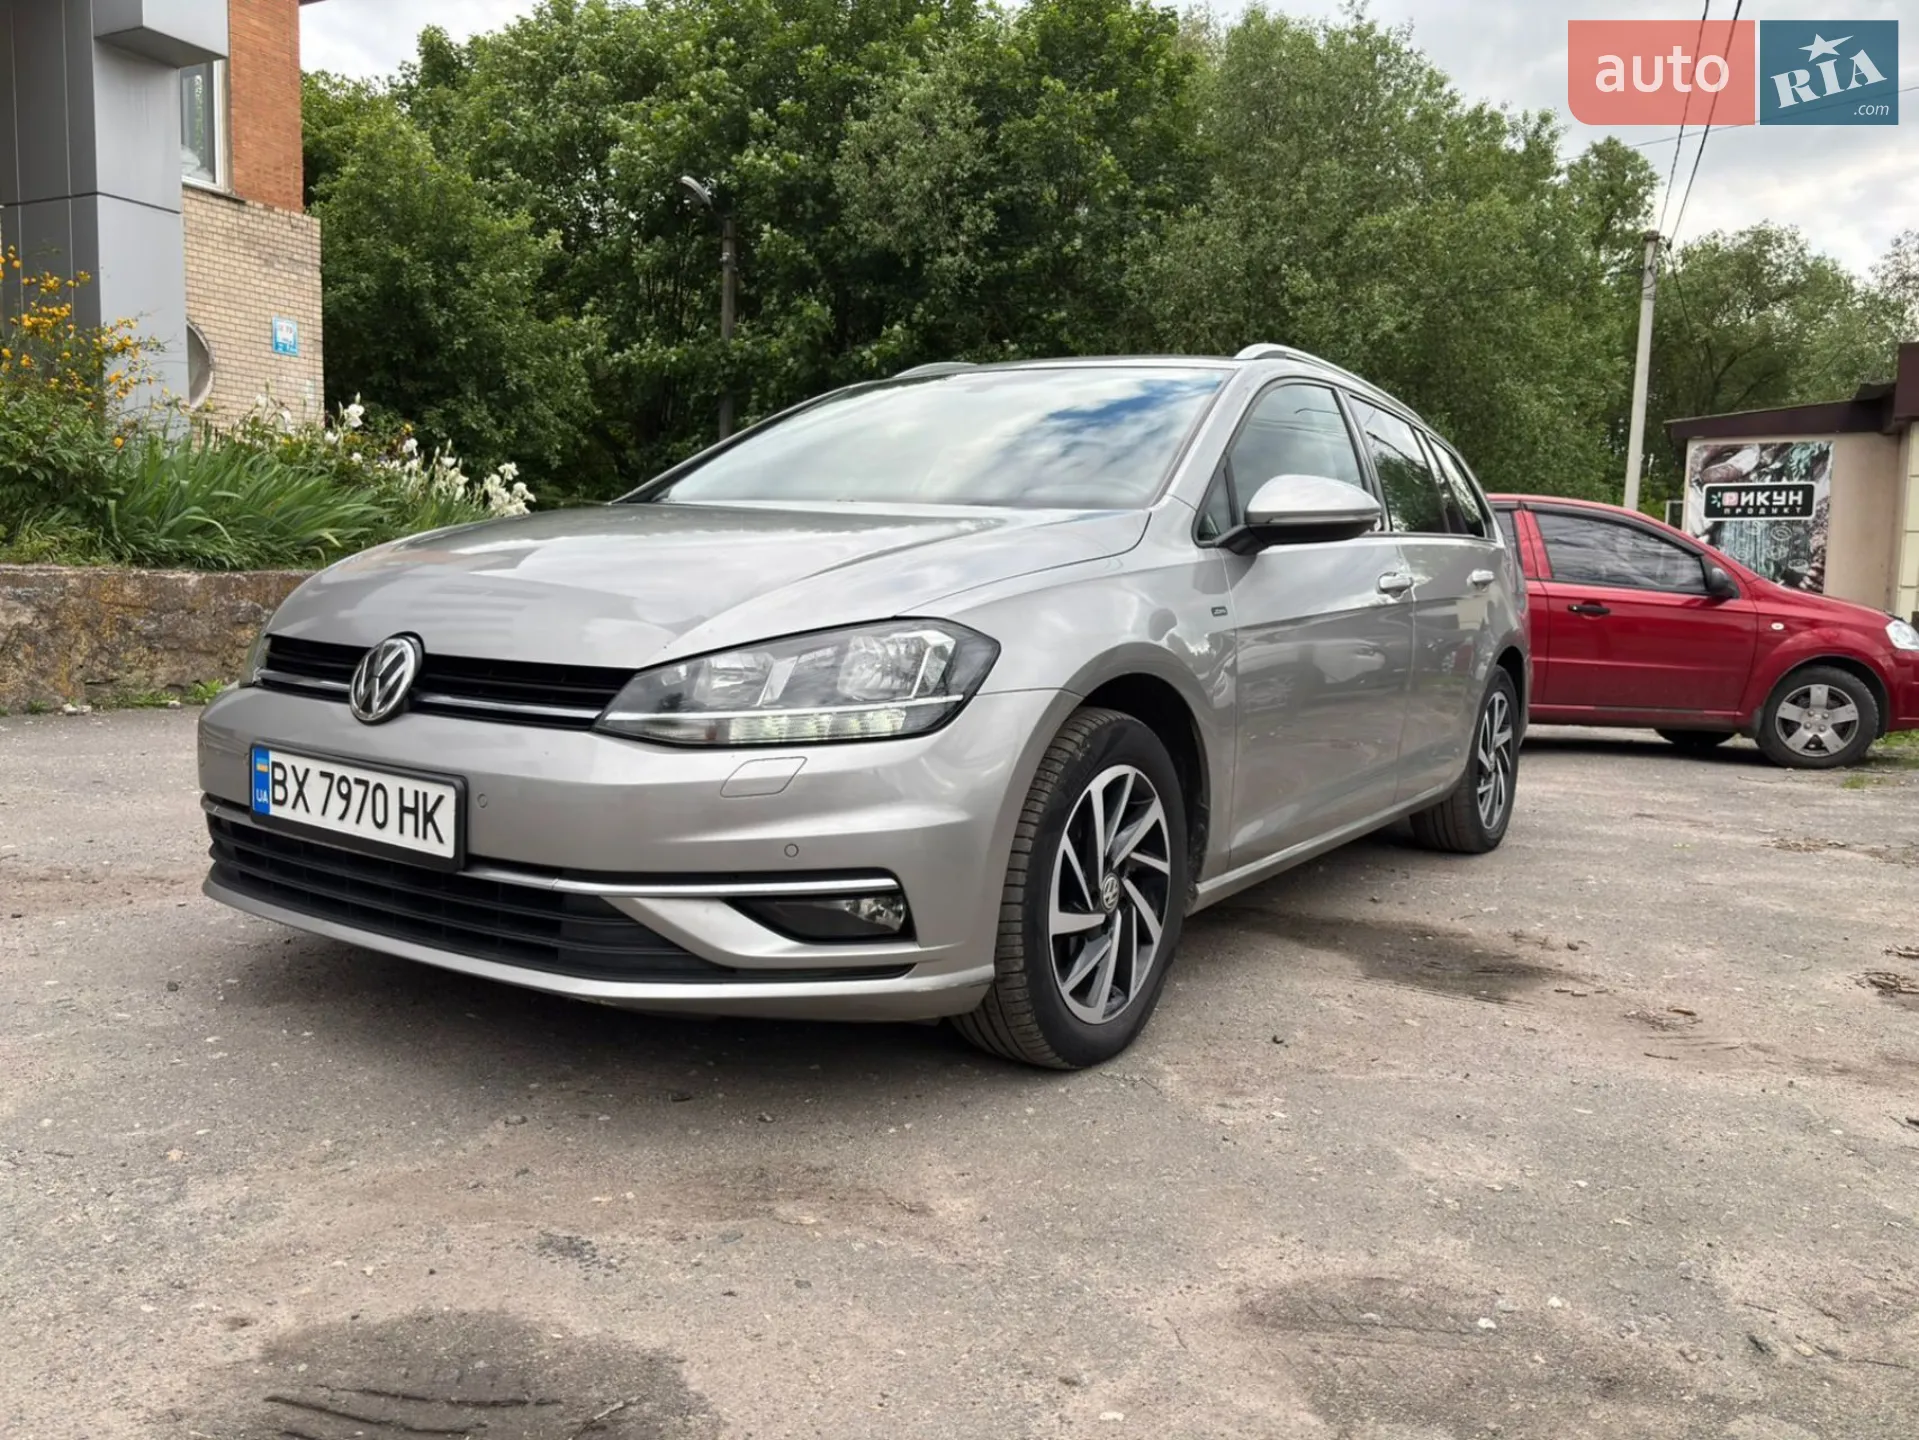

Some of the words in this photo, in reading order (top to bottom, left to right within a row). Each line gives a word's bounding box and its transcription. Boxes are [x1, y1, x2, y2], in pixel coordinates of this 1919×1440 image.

[1722, 491, 1803, 506] РИКУН
[256, 788, 269, 804] UA
[271, 760, 311, 814] BX
[319, 770, 389, 830] 7970
[398, 786, 446, 845] HK
